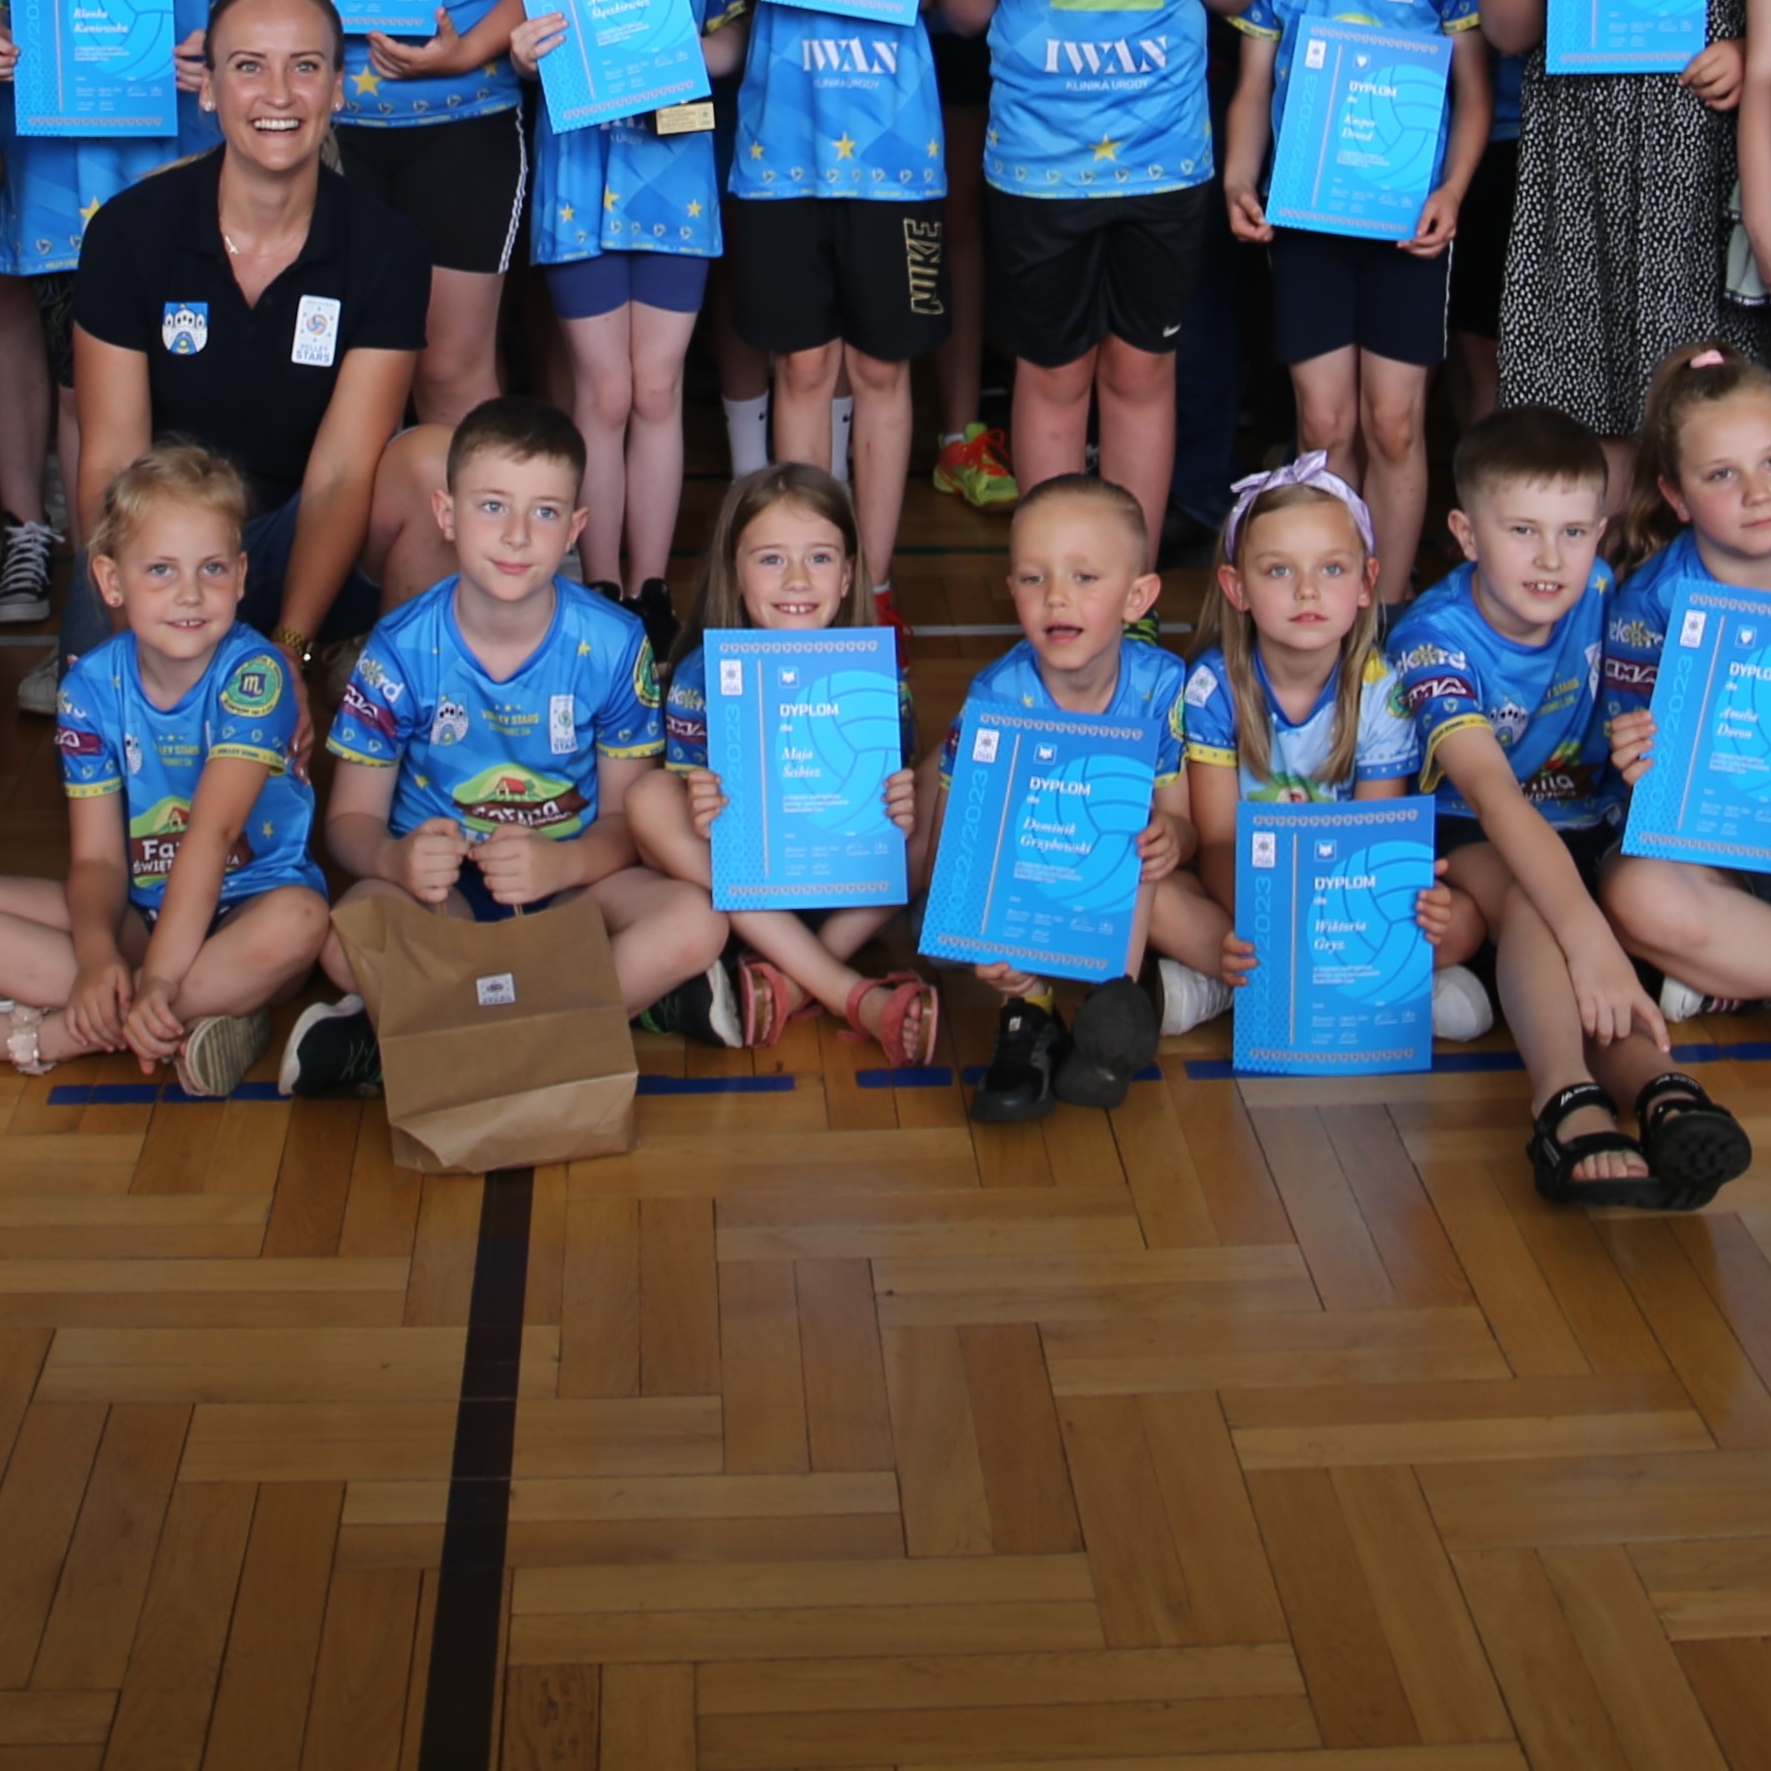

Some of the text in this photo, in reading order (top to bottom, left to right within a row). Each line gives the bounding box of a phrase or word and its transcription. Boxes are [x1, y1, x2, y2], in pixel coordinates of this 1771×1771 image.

[1043, 35, 1168, 76] IWAN
[1065, 78, 1149, 92] KLINIKA URODY
[1348, 80, 1398, 100] DYPLOM
[295, 350, 331, 363] STARS
[779, 703, 839, 717] DYPLOM
[1029, 775, 1091, 797] DYPLOM
[1315, 876, 1376, 891] DYPLOM
